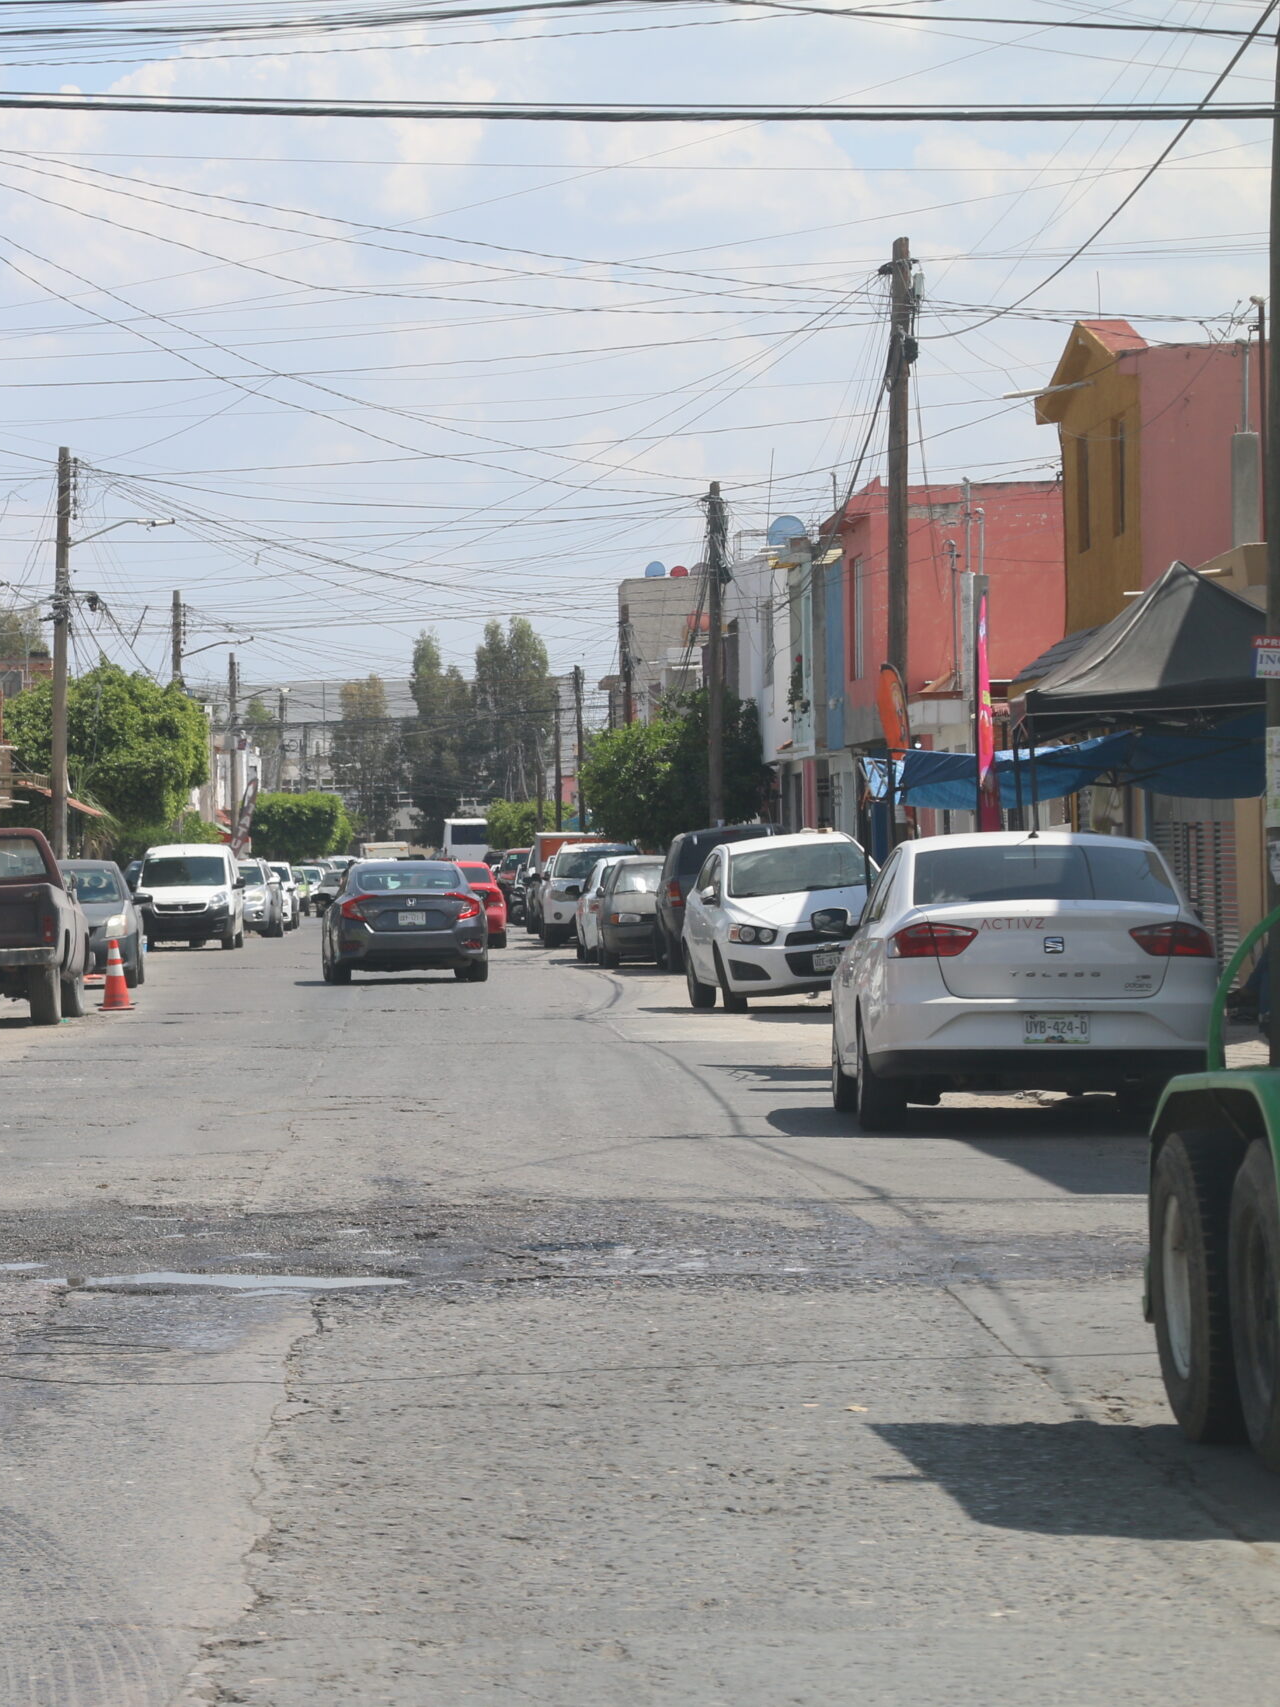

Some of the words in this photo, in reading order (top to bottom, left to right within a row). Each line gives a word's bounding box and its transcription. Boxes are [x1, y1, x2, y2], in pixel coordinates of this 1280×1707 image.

[1255, 638, 1280, 647] APR
[1259, 654, 1280, 665] IN
[1009, 970, 1101, 978] TOLEDO
[1025, 1020, 1088, 1034] UYB-424-D
